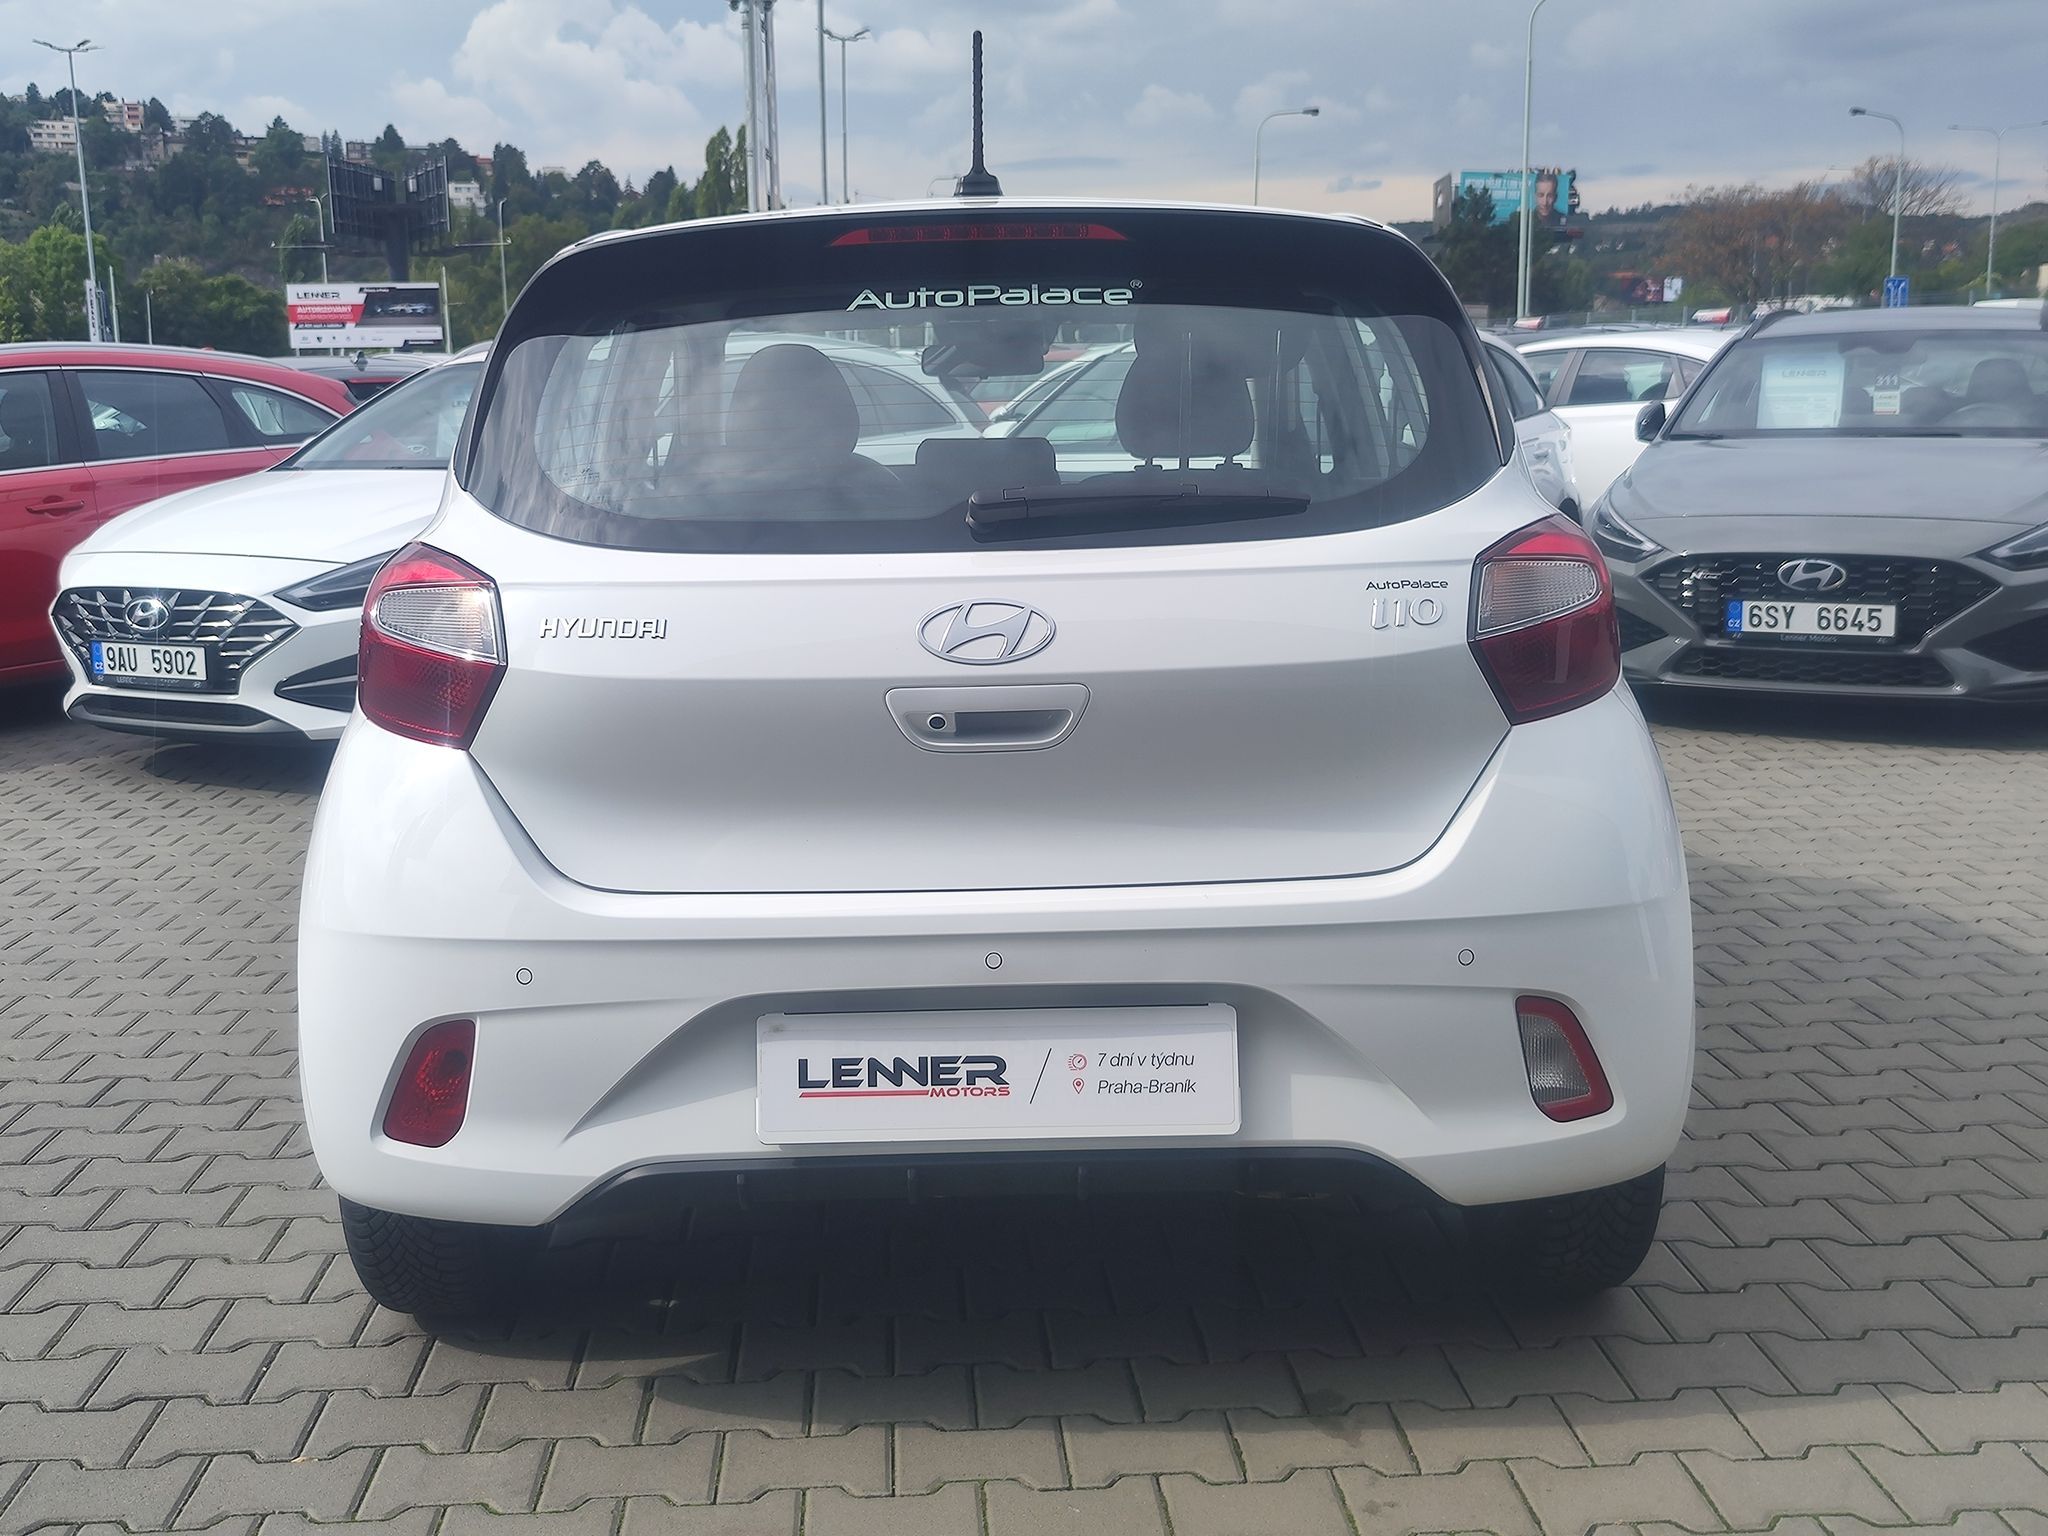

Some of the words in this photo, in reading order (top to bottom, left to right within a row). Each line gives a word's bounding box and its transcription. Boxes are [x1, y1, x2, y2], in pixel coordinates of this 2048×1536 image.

[1366, 580, 1449, 590] AutoPalace
[1726, 619, 1742, 628] CZ
[1748, 604, 1796, 630] 6SY
[1816, 606, 1883, 632] 6645
[539, 617, 668, 640] HYUNDAI
[95, 661, 104, 670] CZ
[106, 646, 138, 673] 9AU
[151, 648, 198, 676] 5902
[1098, 1052, 1107, 1066] 7
[1109, 1052, 1135, 1067] dní
[1137, 1055, 1147, 1066] v
[1151, 1052, 1194, 1069] týdnu
[798, 1055, 1010, 1089] LENNER
[929, 1086, 1011, 1098] MOTORS
[1097, 1079, 1196, 1094] Praha-Braník
